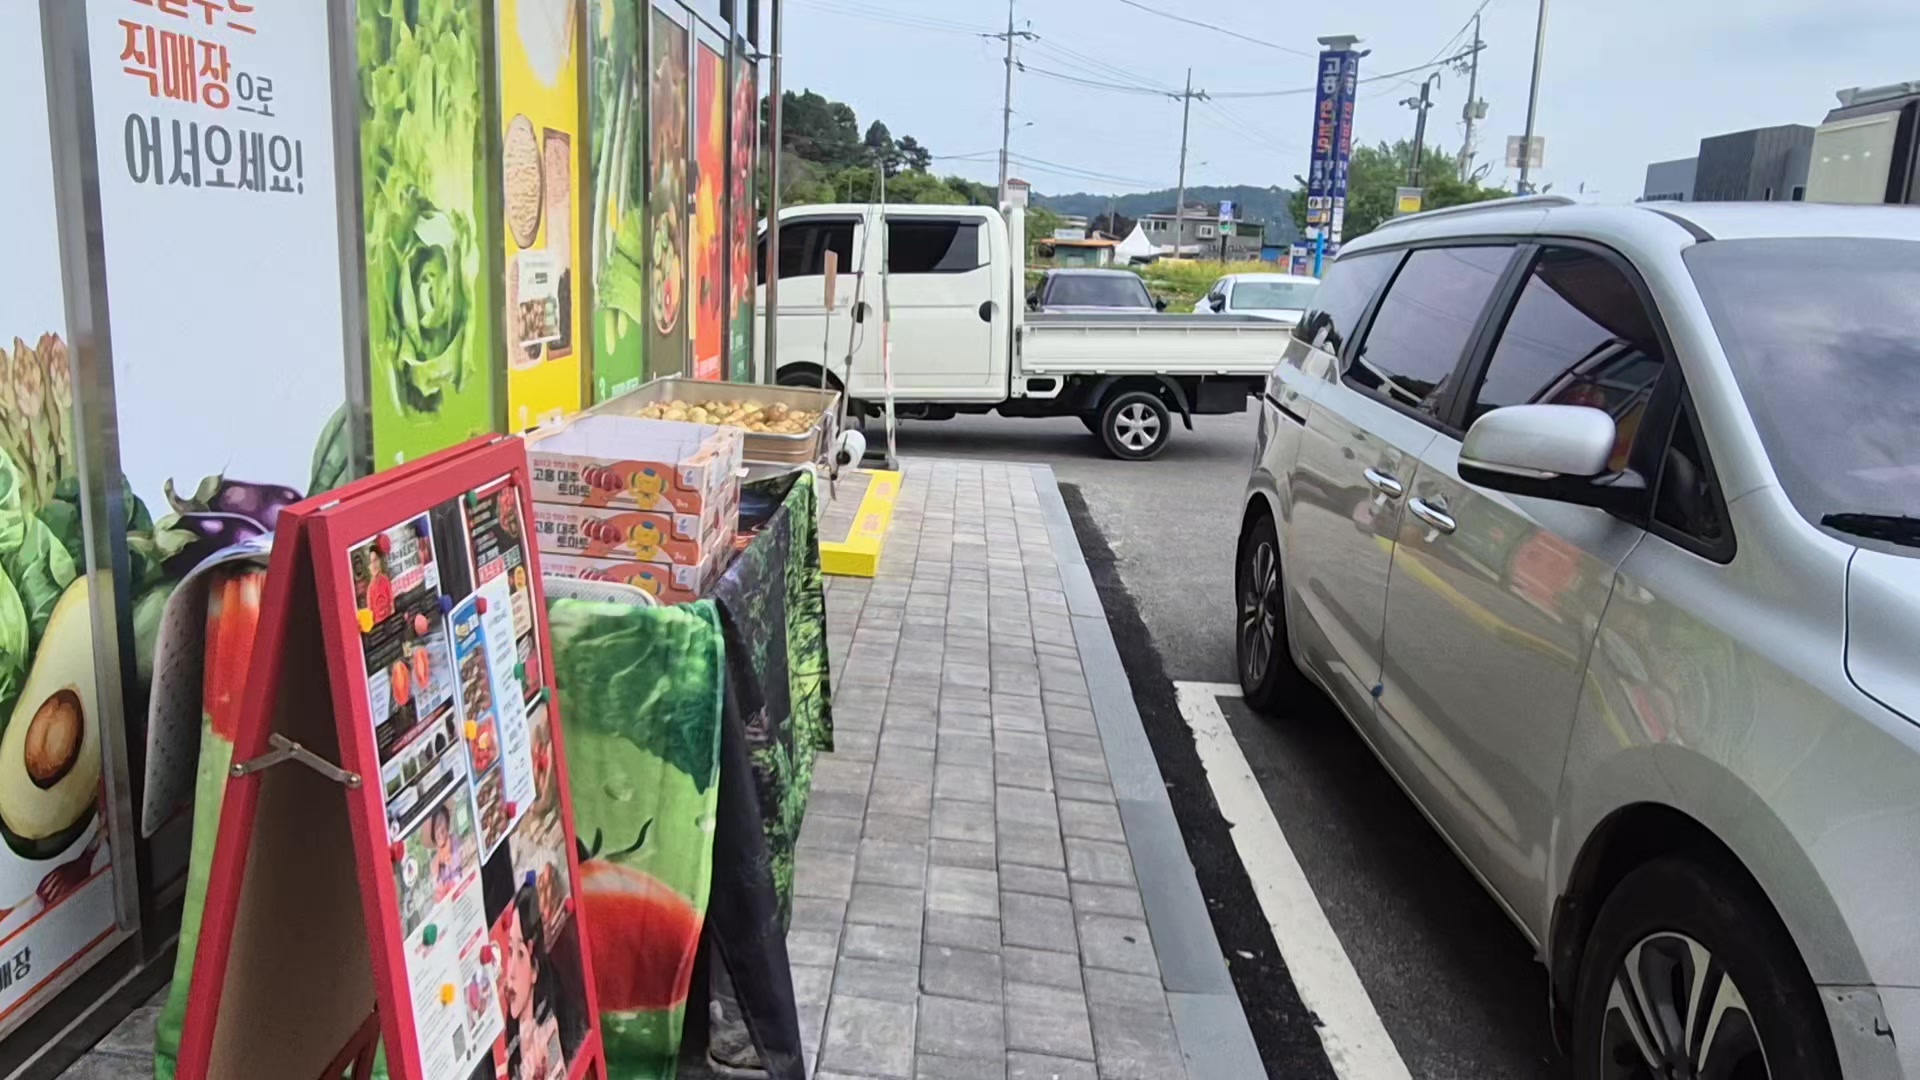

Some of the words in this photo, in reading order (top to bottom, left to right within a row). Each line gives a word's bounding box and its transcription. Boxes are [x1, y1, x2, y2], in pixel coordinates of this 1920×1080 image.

[124, 113, 304, 195] 어서오세요!
[533, 468, 555, 482] 고흥
[558, 470, 581, 484] 대추
[558, 483, 591, 498] 토마토
[535, 520, 554, 535] 고흥
[556, 522, 579, 536] 대추
[557, 535, 590, 550] 토마토
